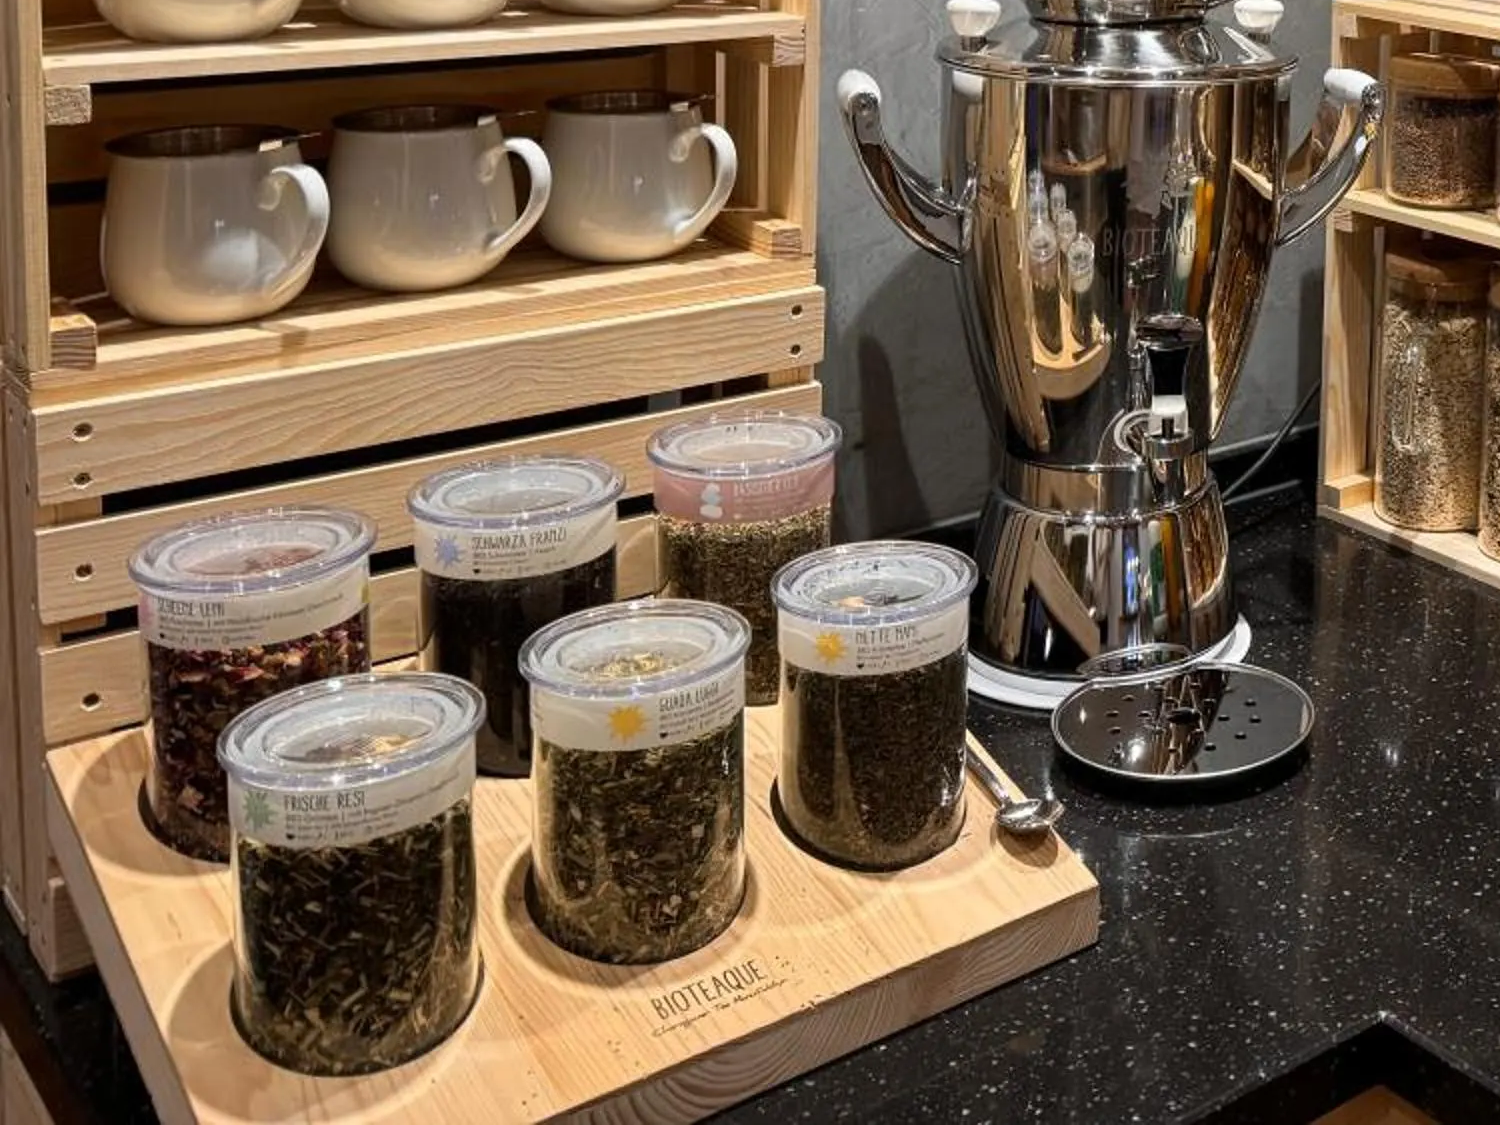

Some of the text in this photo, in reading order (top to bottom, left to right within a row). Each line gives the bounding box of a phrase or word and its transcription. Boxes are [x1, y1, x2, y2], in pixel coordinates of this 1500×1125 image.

[284, 790, 365, 812] FRISCHE RESI
[651, 960, 767, 1020] BIOTEAQUE
